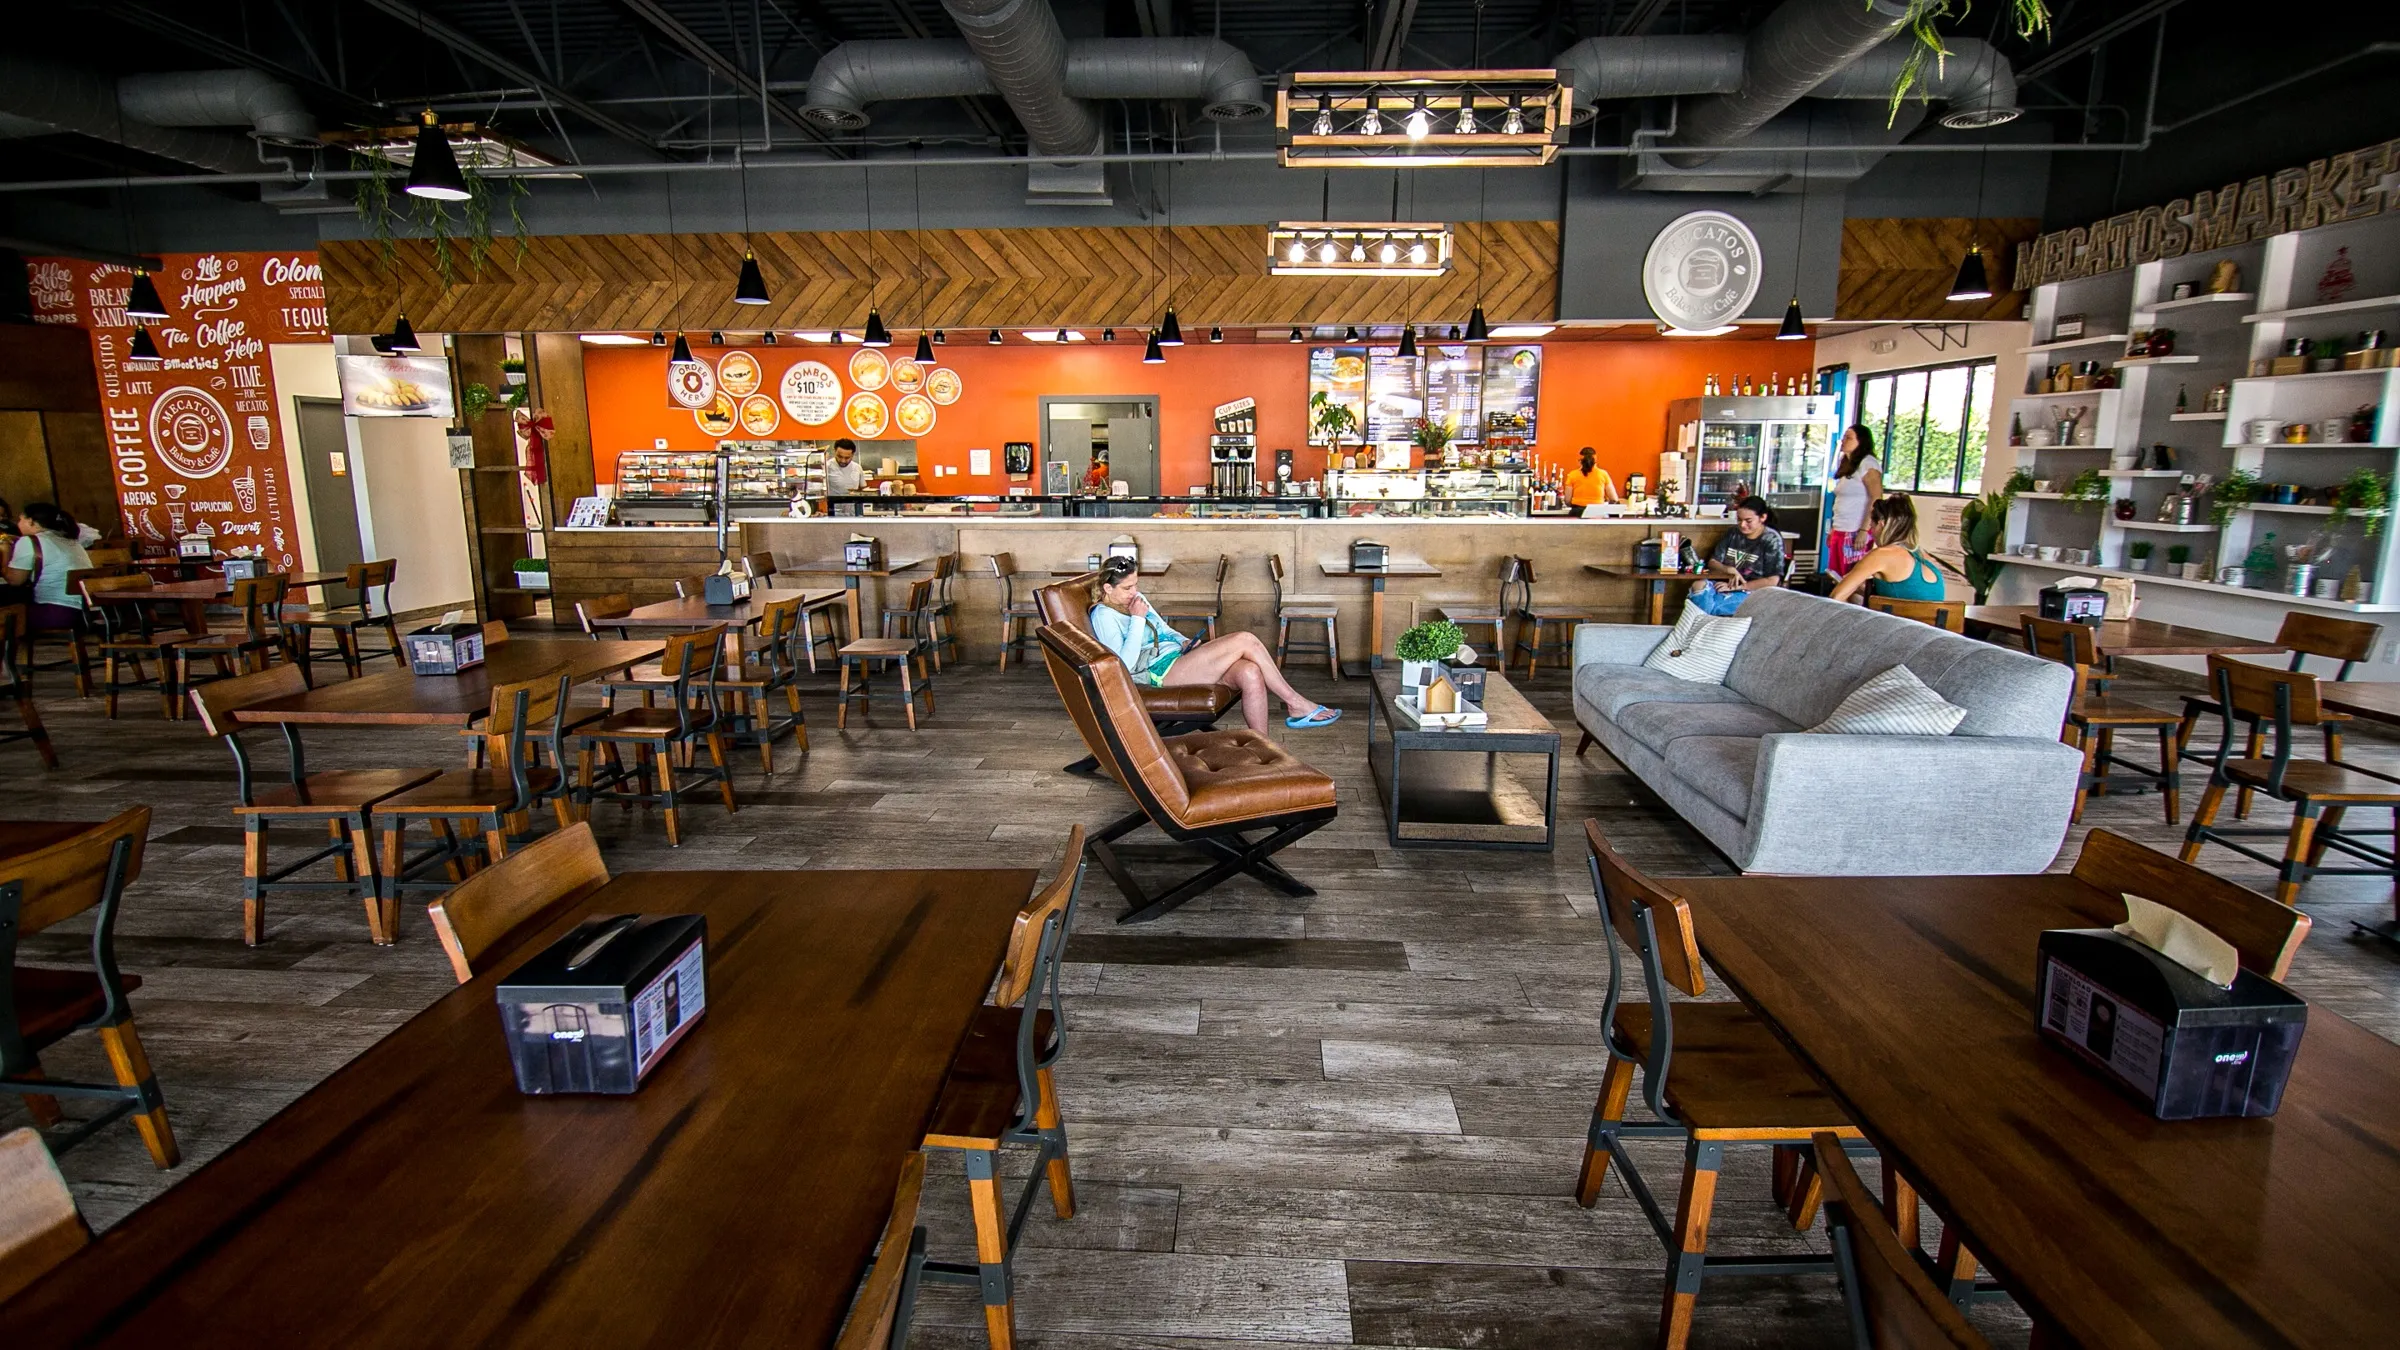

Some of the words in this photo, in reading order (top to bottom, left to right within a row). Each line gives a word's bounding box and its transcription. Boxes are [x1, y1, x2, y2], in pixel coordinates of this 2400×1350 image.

[1666, 227, 1744, 258] MECATOS
[2012, 198, 2192, 291] MECATOS
[196, 255, 222, 281] Life
[89, 287, 132, 307] BREAK
[180, 276, 246, 310] Happens
[1713, 288, 1739, 311] Café
[33, 314, 78, 324] FRAPPES
[162, 328, 190, 348] Tea
[196, 318, 245, 348] Coffee
[224, 338, 263, 363] Helps
[98, 334, 121, 398] QUESITOS
[122, 361, 160, 373] EMPANADAS
[229, 365, 266, 388] TIME
[678, 363, 708, 378] ORDER
[126, 381, 153, 396] LATTE
[788, 368, 834, 388] COMBOS
[235, 400, 269, 412] MECATOS
[680, 389, 707, 402] HERE
[162, 400, 217, 424] MECATOS
[1219, 406, 1231, 414] CUP
[1233, 400, 1250, 409] SIZES
[110, 407, 149, 487] COFFEE
[169, 446, 197, 468] Bakery
[204, 447, 221, 465] Café
[123, 491, 158, 506] AREPAS
[263, 467, 281, 522] SPECIALTY
[190, 501, 234, 513] CAPPUCCINO
[221, 521, 261, 535] Desserts
